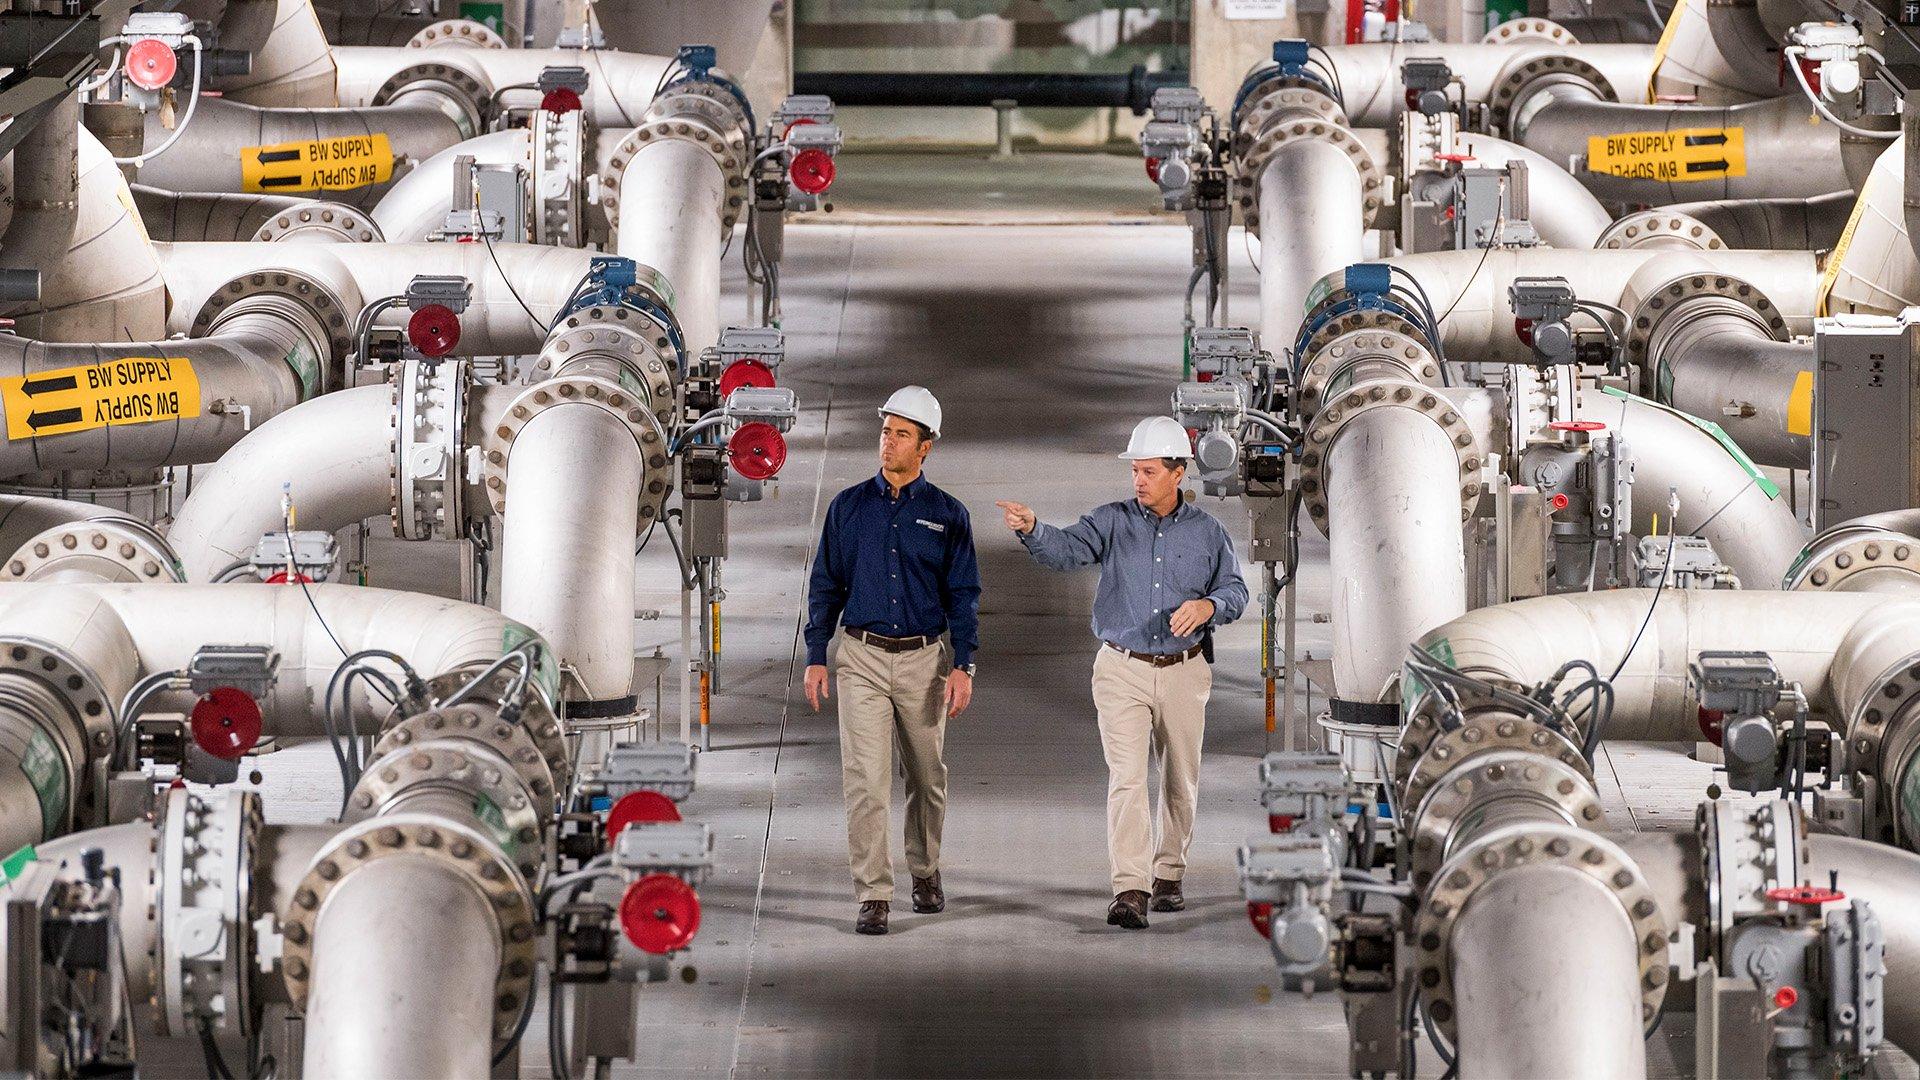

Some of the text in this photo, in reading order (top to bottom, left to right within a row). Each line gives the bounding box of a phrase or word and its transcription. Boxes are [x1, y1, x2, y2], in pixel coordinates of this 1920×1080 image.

[309, 138, 374, 162] BW SUPPLY
[1607, 134, 1676, 156] BW SUPPLY
[310, 164, 377, 187] BW SUPPLY
[1658, 161, 1678, 178] BW
[1827, 248, 1846, 278] WASTE
[86, 361, 172, 389] BW SUPPLY
[95, 391, 179, 423] BW SUPPLY
